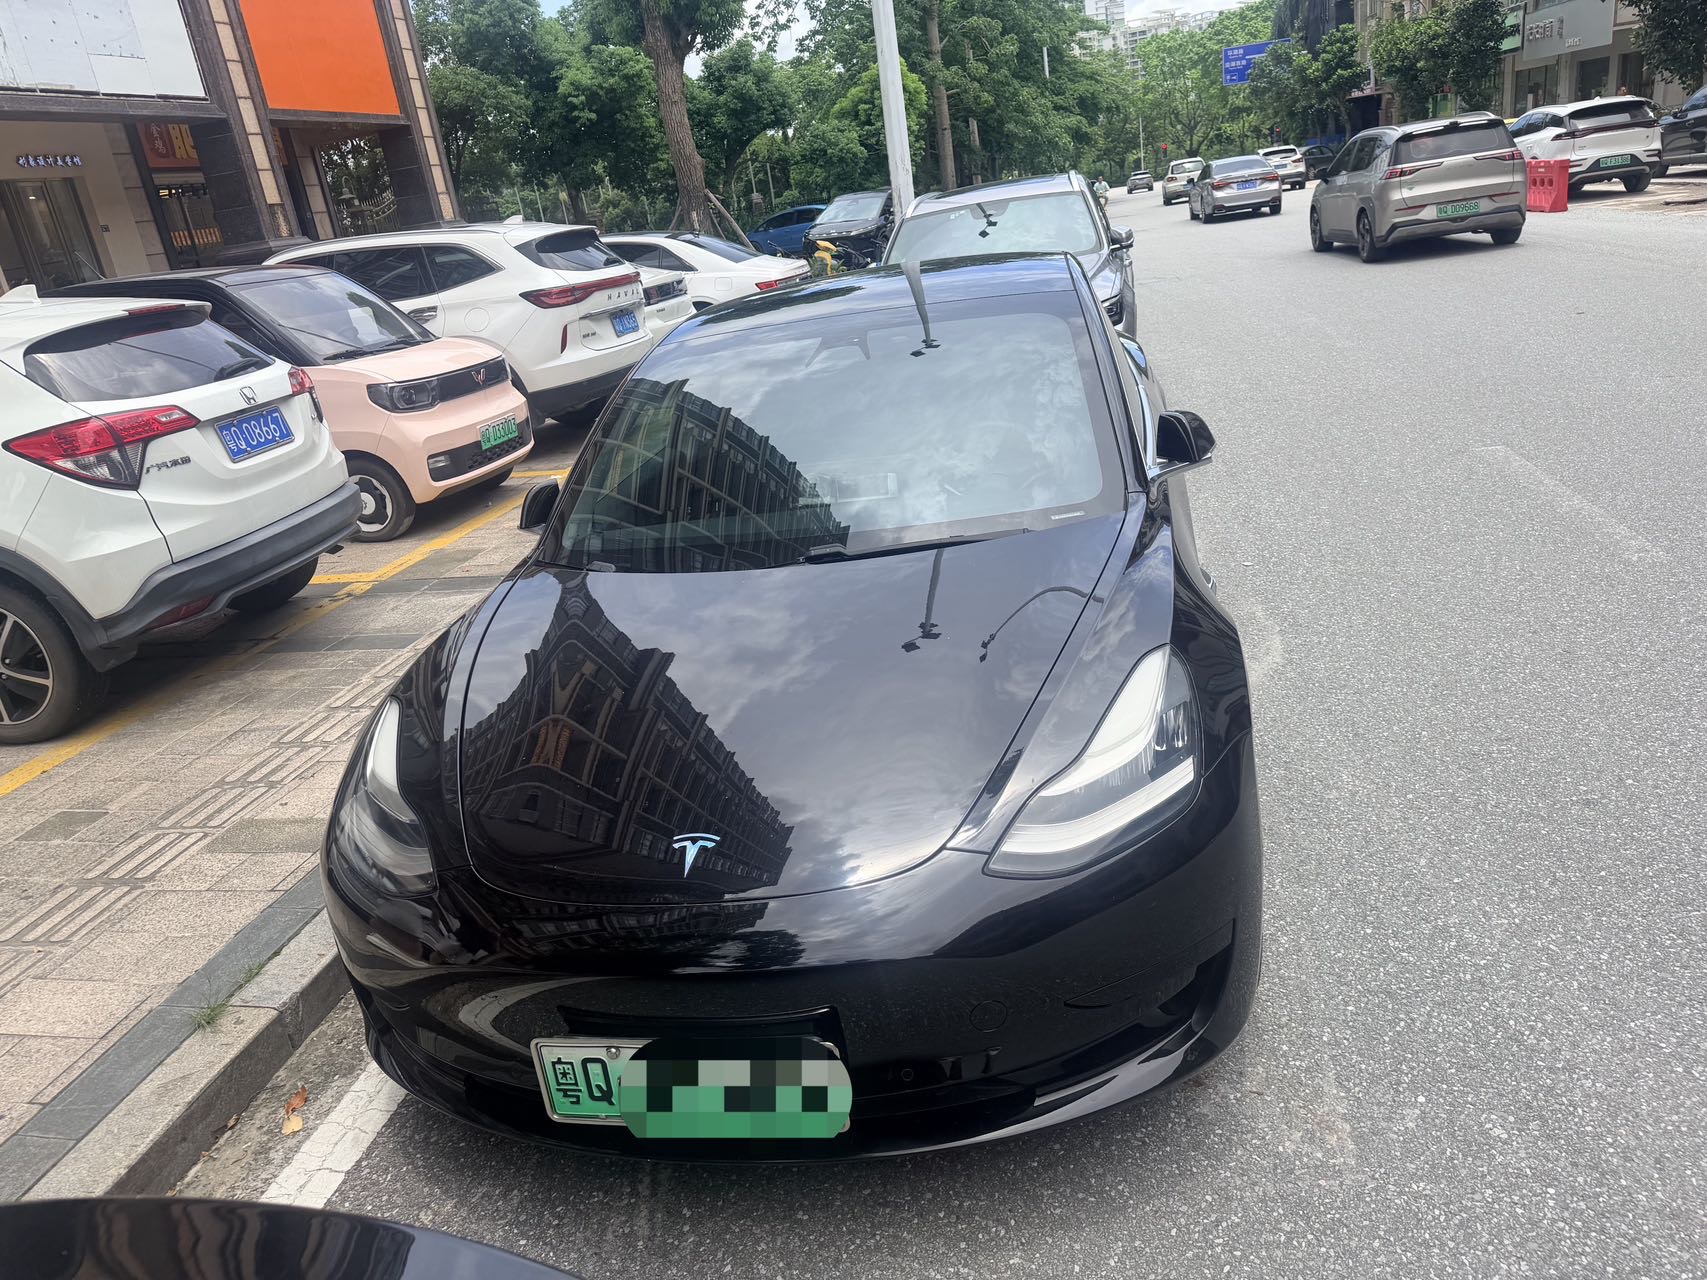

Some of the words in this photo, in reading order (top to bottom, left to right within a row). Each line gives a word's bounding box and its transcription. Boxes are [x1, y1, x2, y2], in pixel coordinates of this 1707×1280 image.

[607, 288, 640, 301] HAVAL
[145, 455, 191, 475] 广汽本田
[550, 1056, 616, 1106] 粤Q
